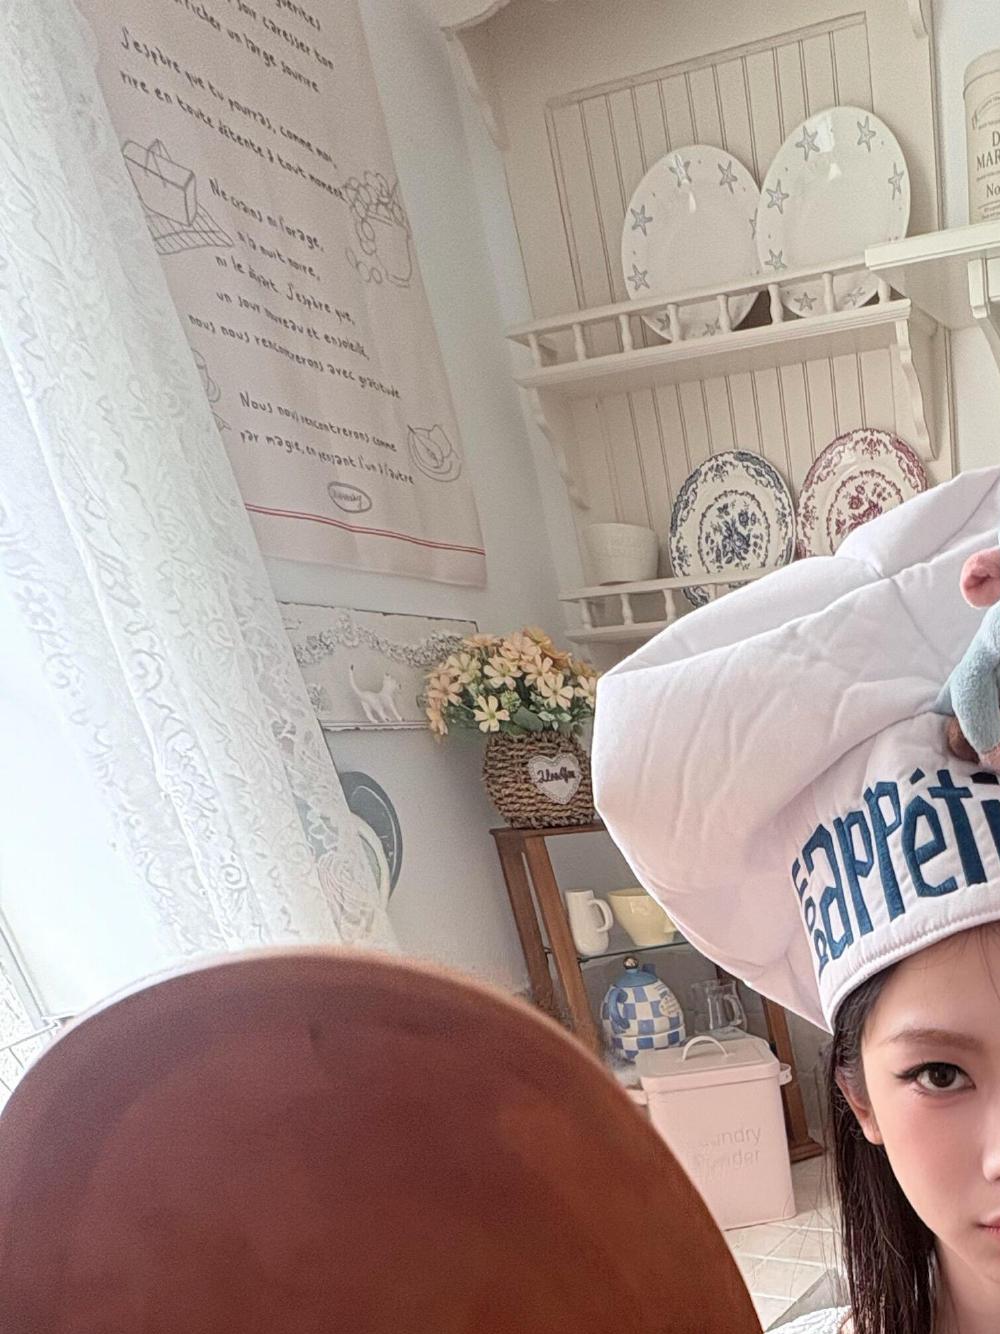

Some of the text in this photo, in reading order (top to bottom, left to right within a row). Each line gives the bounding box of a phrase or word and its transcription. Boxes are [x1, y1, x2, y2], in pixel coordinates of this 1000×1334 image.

[209, 178, 227, 201] Ne
[221, 326, 250, 343] nous
[327, 363, 355, 381] avec
[240, 391, 273, 413] Nous
